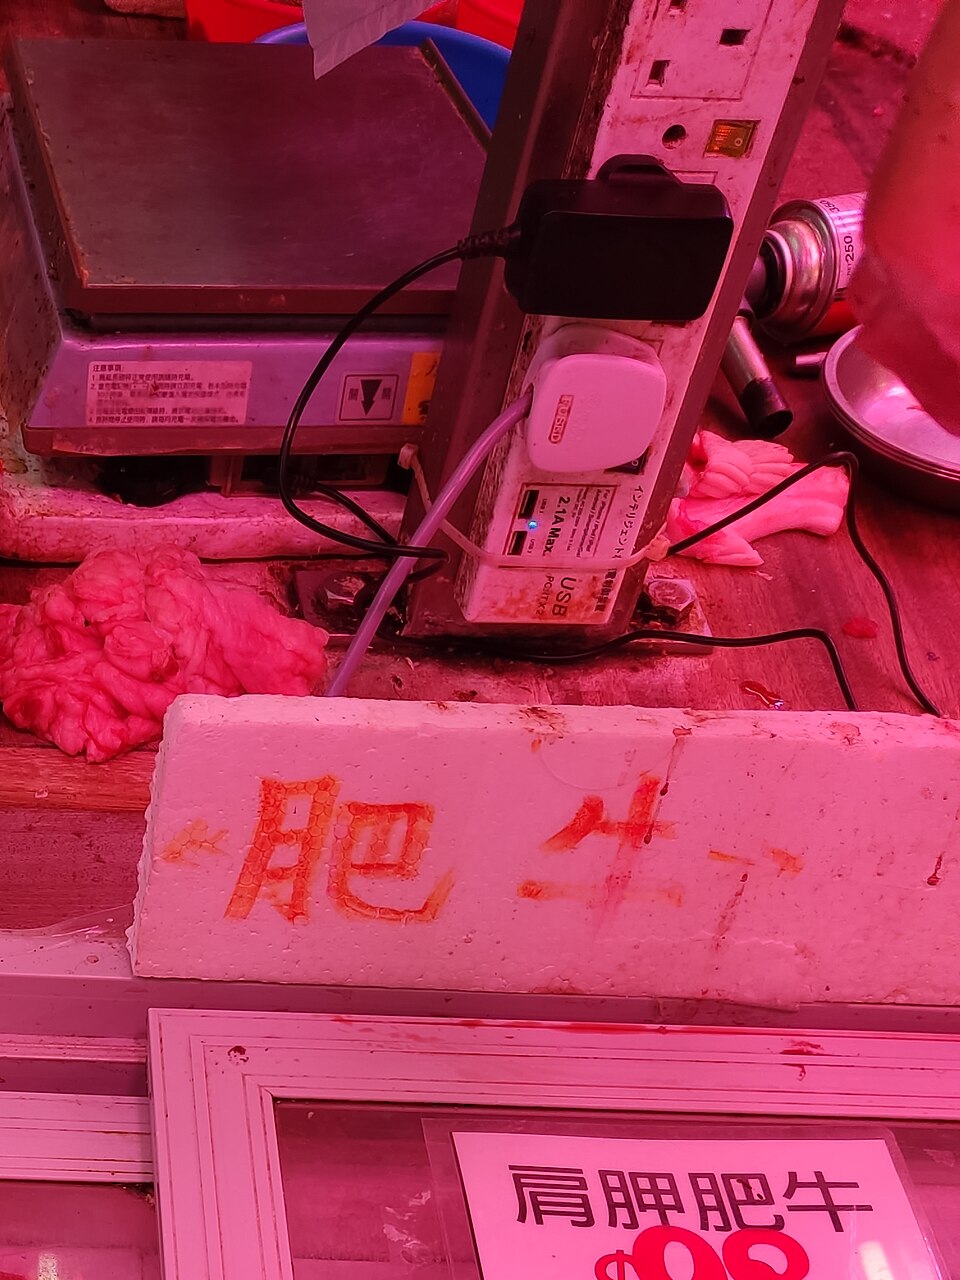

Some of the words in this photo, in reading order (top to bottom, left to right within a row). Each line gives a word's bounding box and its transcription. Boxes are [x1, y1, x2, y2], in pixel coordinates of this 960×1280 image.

[843, 235, 855, 262] 250
[551, 496, 571, 525] 2.1A
[552, 577, 577, 616] USB
[508, 1164, 873, 1233] 肩胛肥牛
